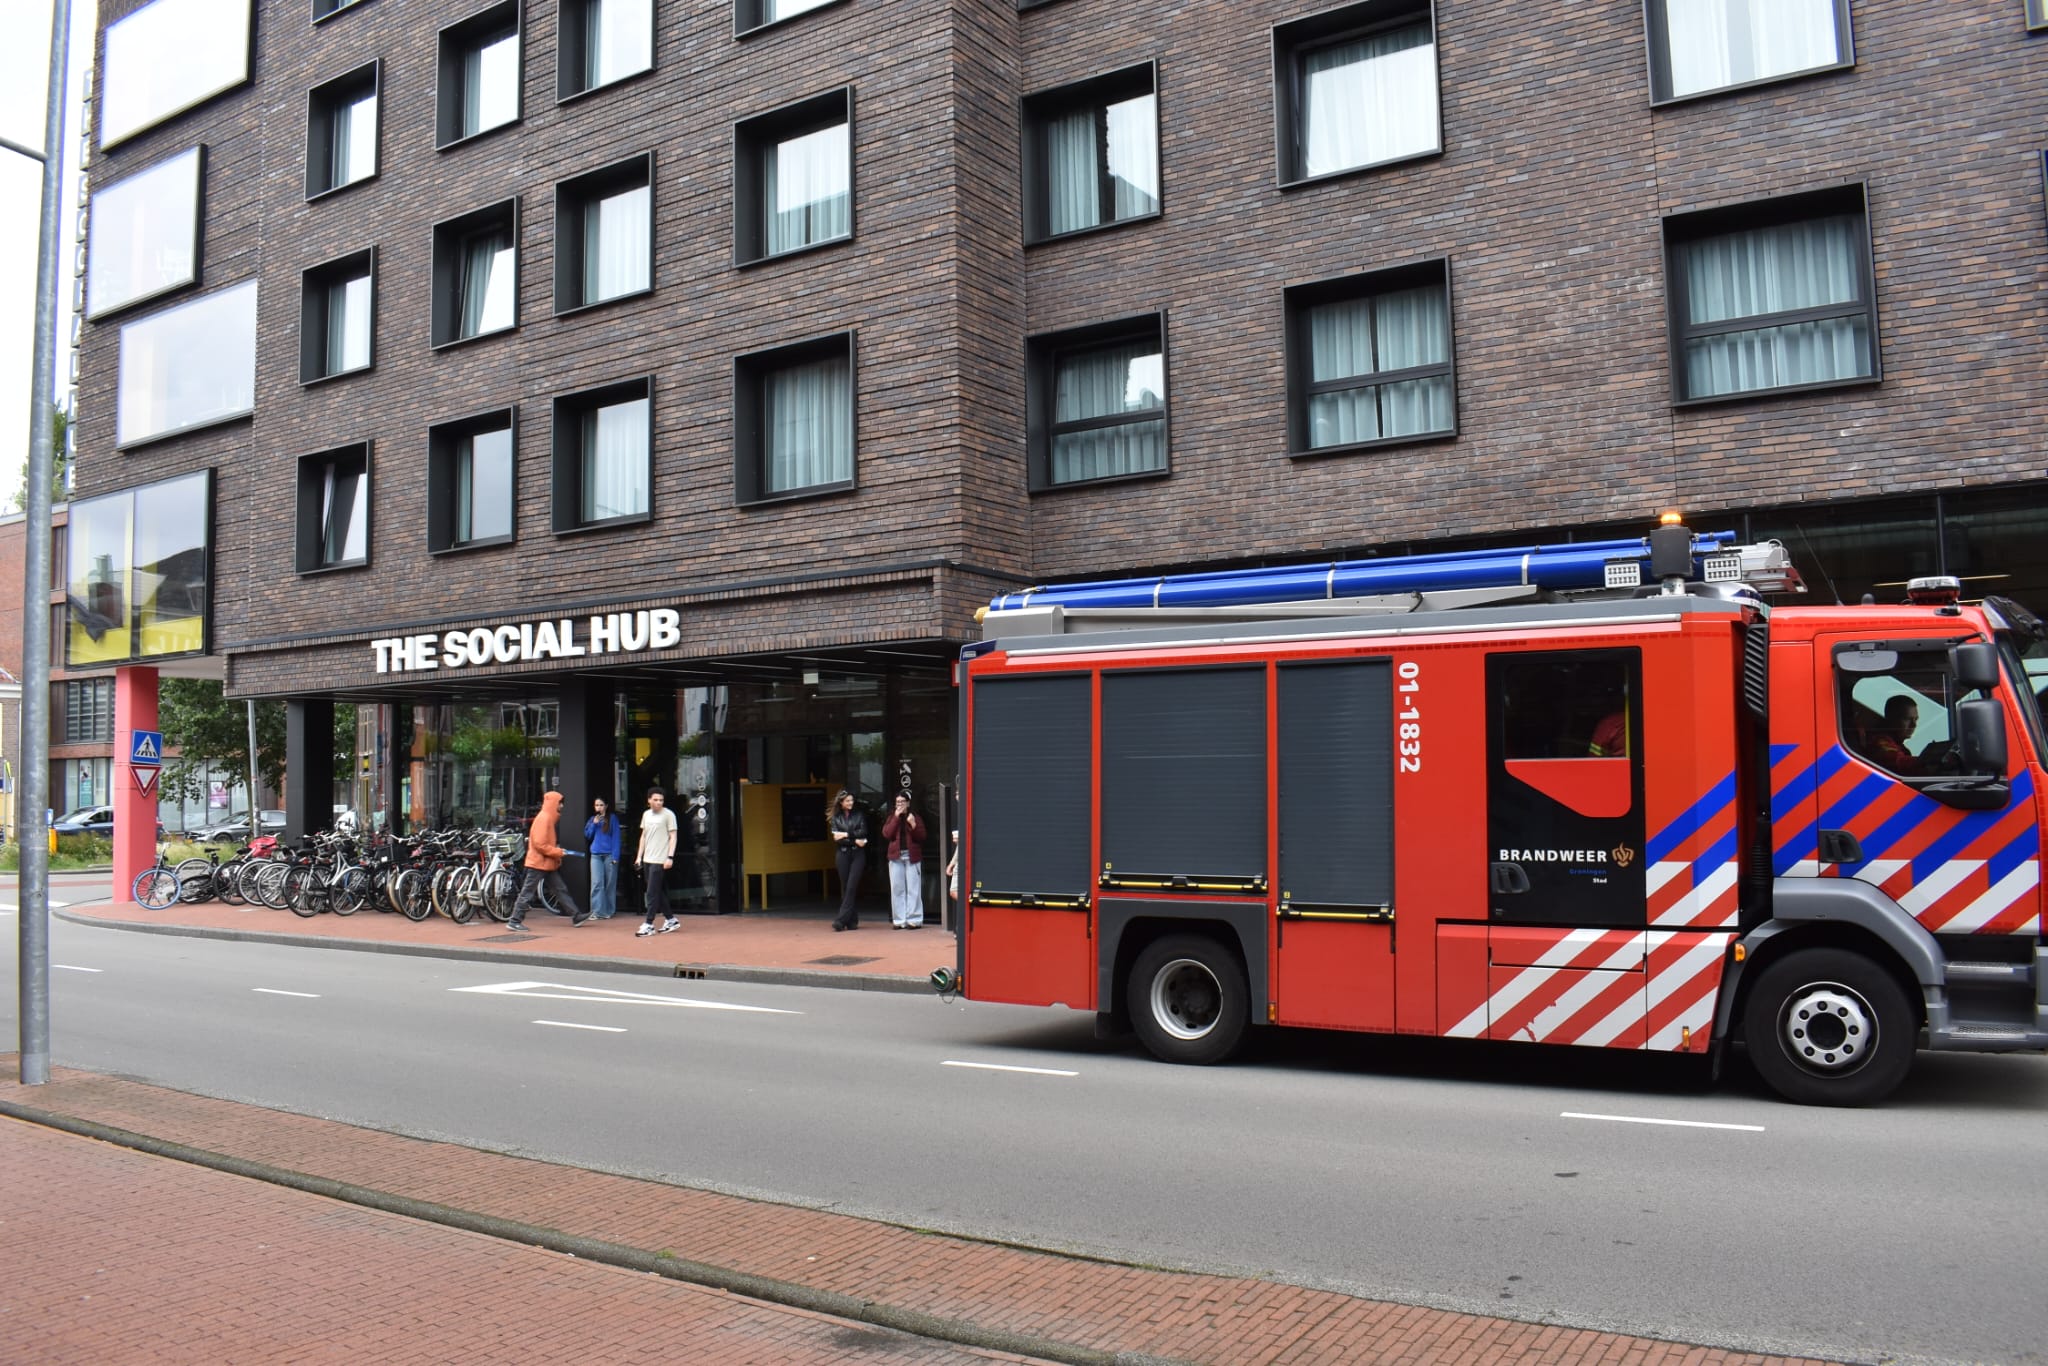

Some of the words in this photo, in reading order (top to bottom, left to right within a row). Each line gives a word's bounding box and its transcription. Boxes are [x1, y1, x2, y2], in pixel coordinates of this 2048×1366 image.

[371, 633, 439, 674] THE
[443, 619, 585, 669] SOCIAL
[590, 607, 681, 654] HUB
[1398, 661, 1422, 774] 01-1832
[1499, 849, 1608, 862] BRANDWEER
